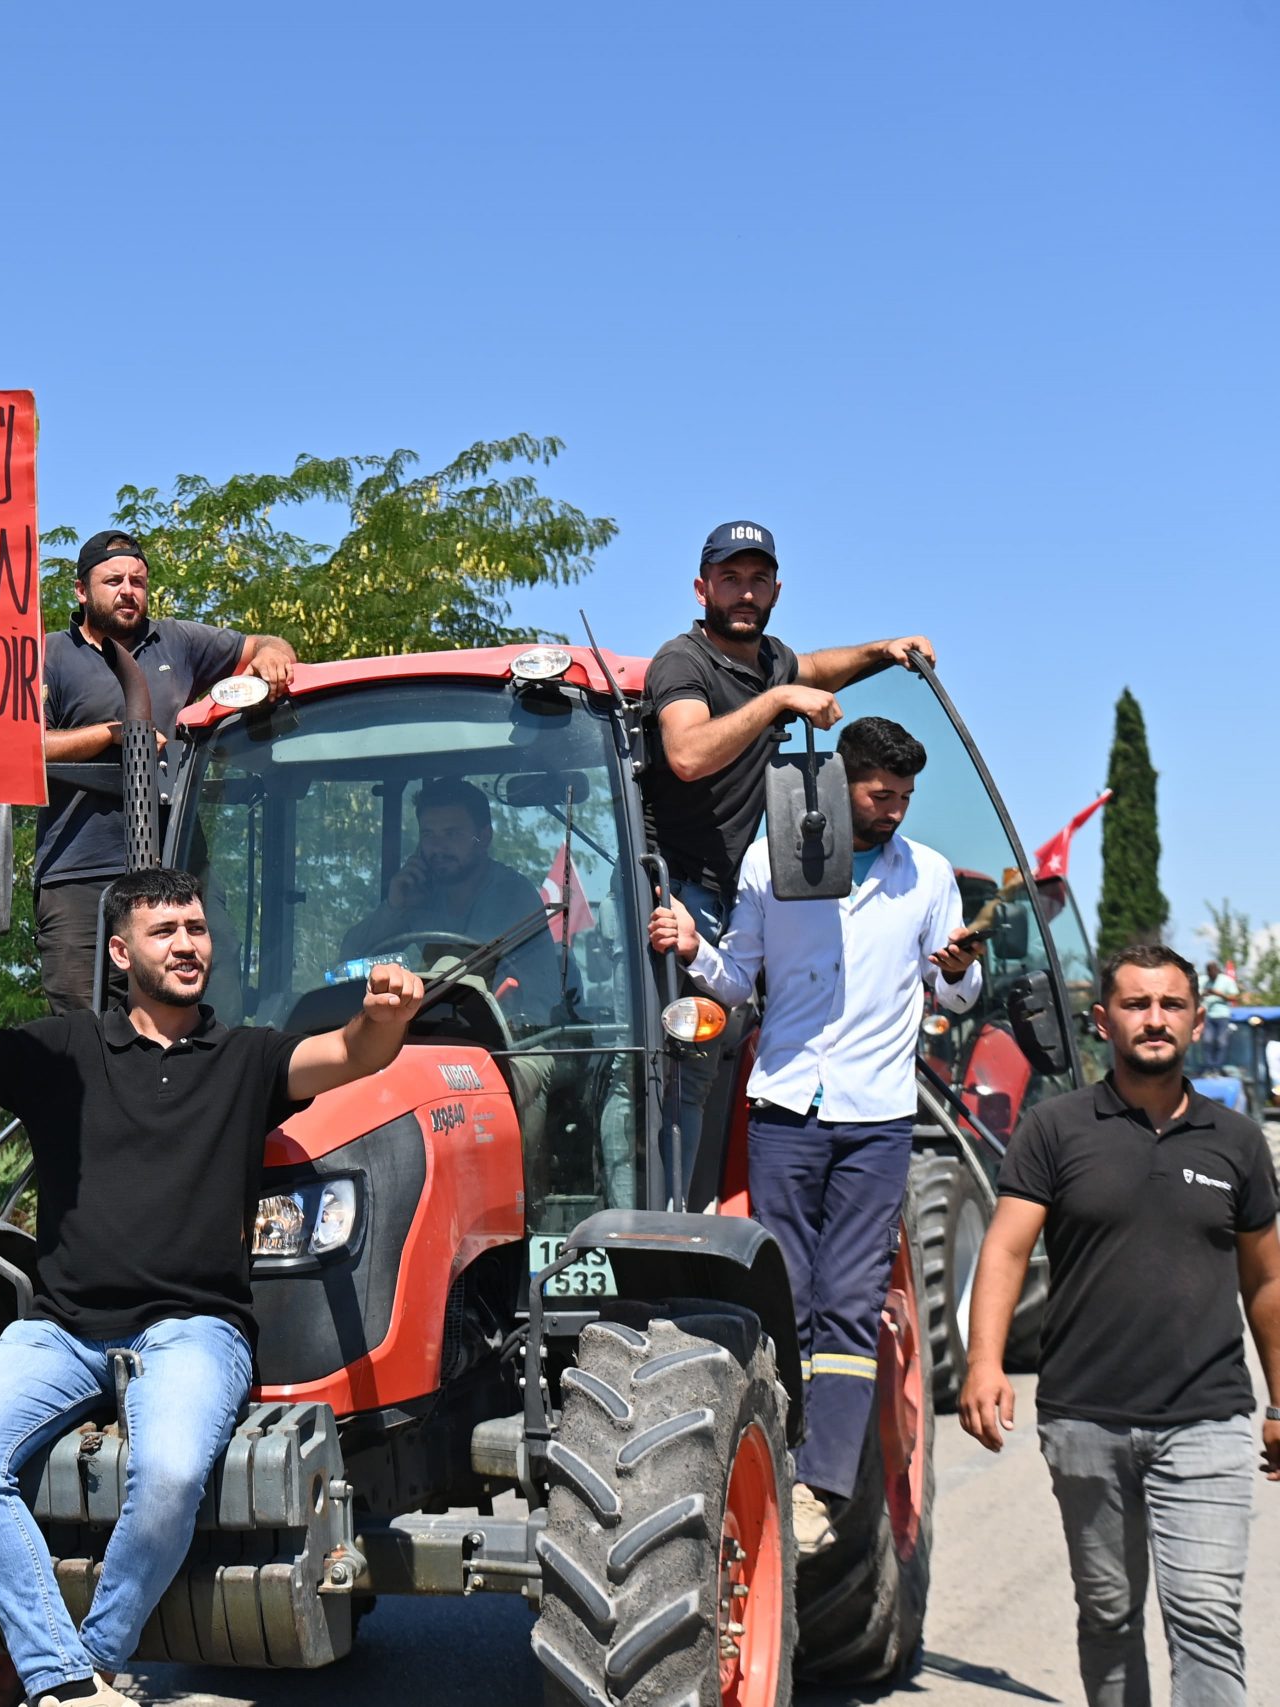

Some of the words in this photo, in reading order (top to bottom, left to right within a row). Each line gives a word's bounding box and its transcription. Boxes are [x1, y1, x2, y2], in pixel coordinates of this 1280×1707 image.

[731, 526, 762, 542] ICON
[438, 1064, 483, 1090] KUBOTA
[429, 1103, 465, 1136] M9540
[555, 1271, 607, 1296] 533
